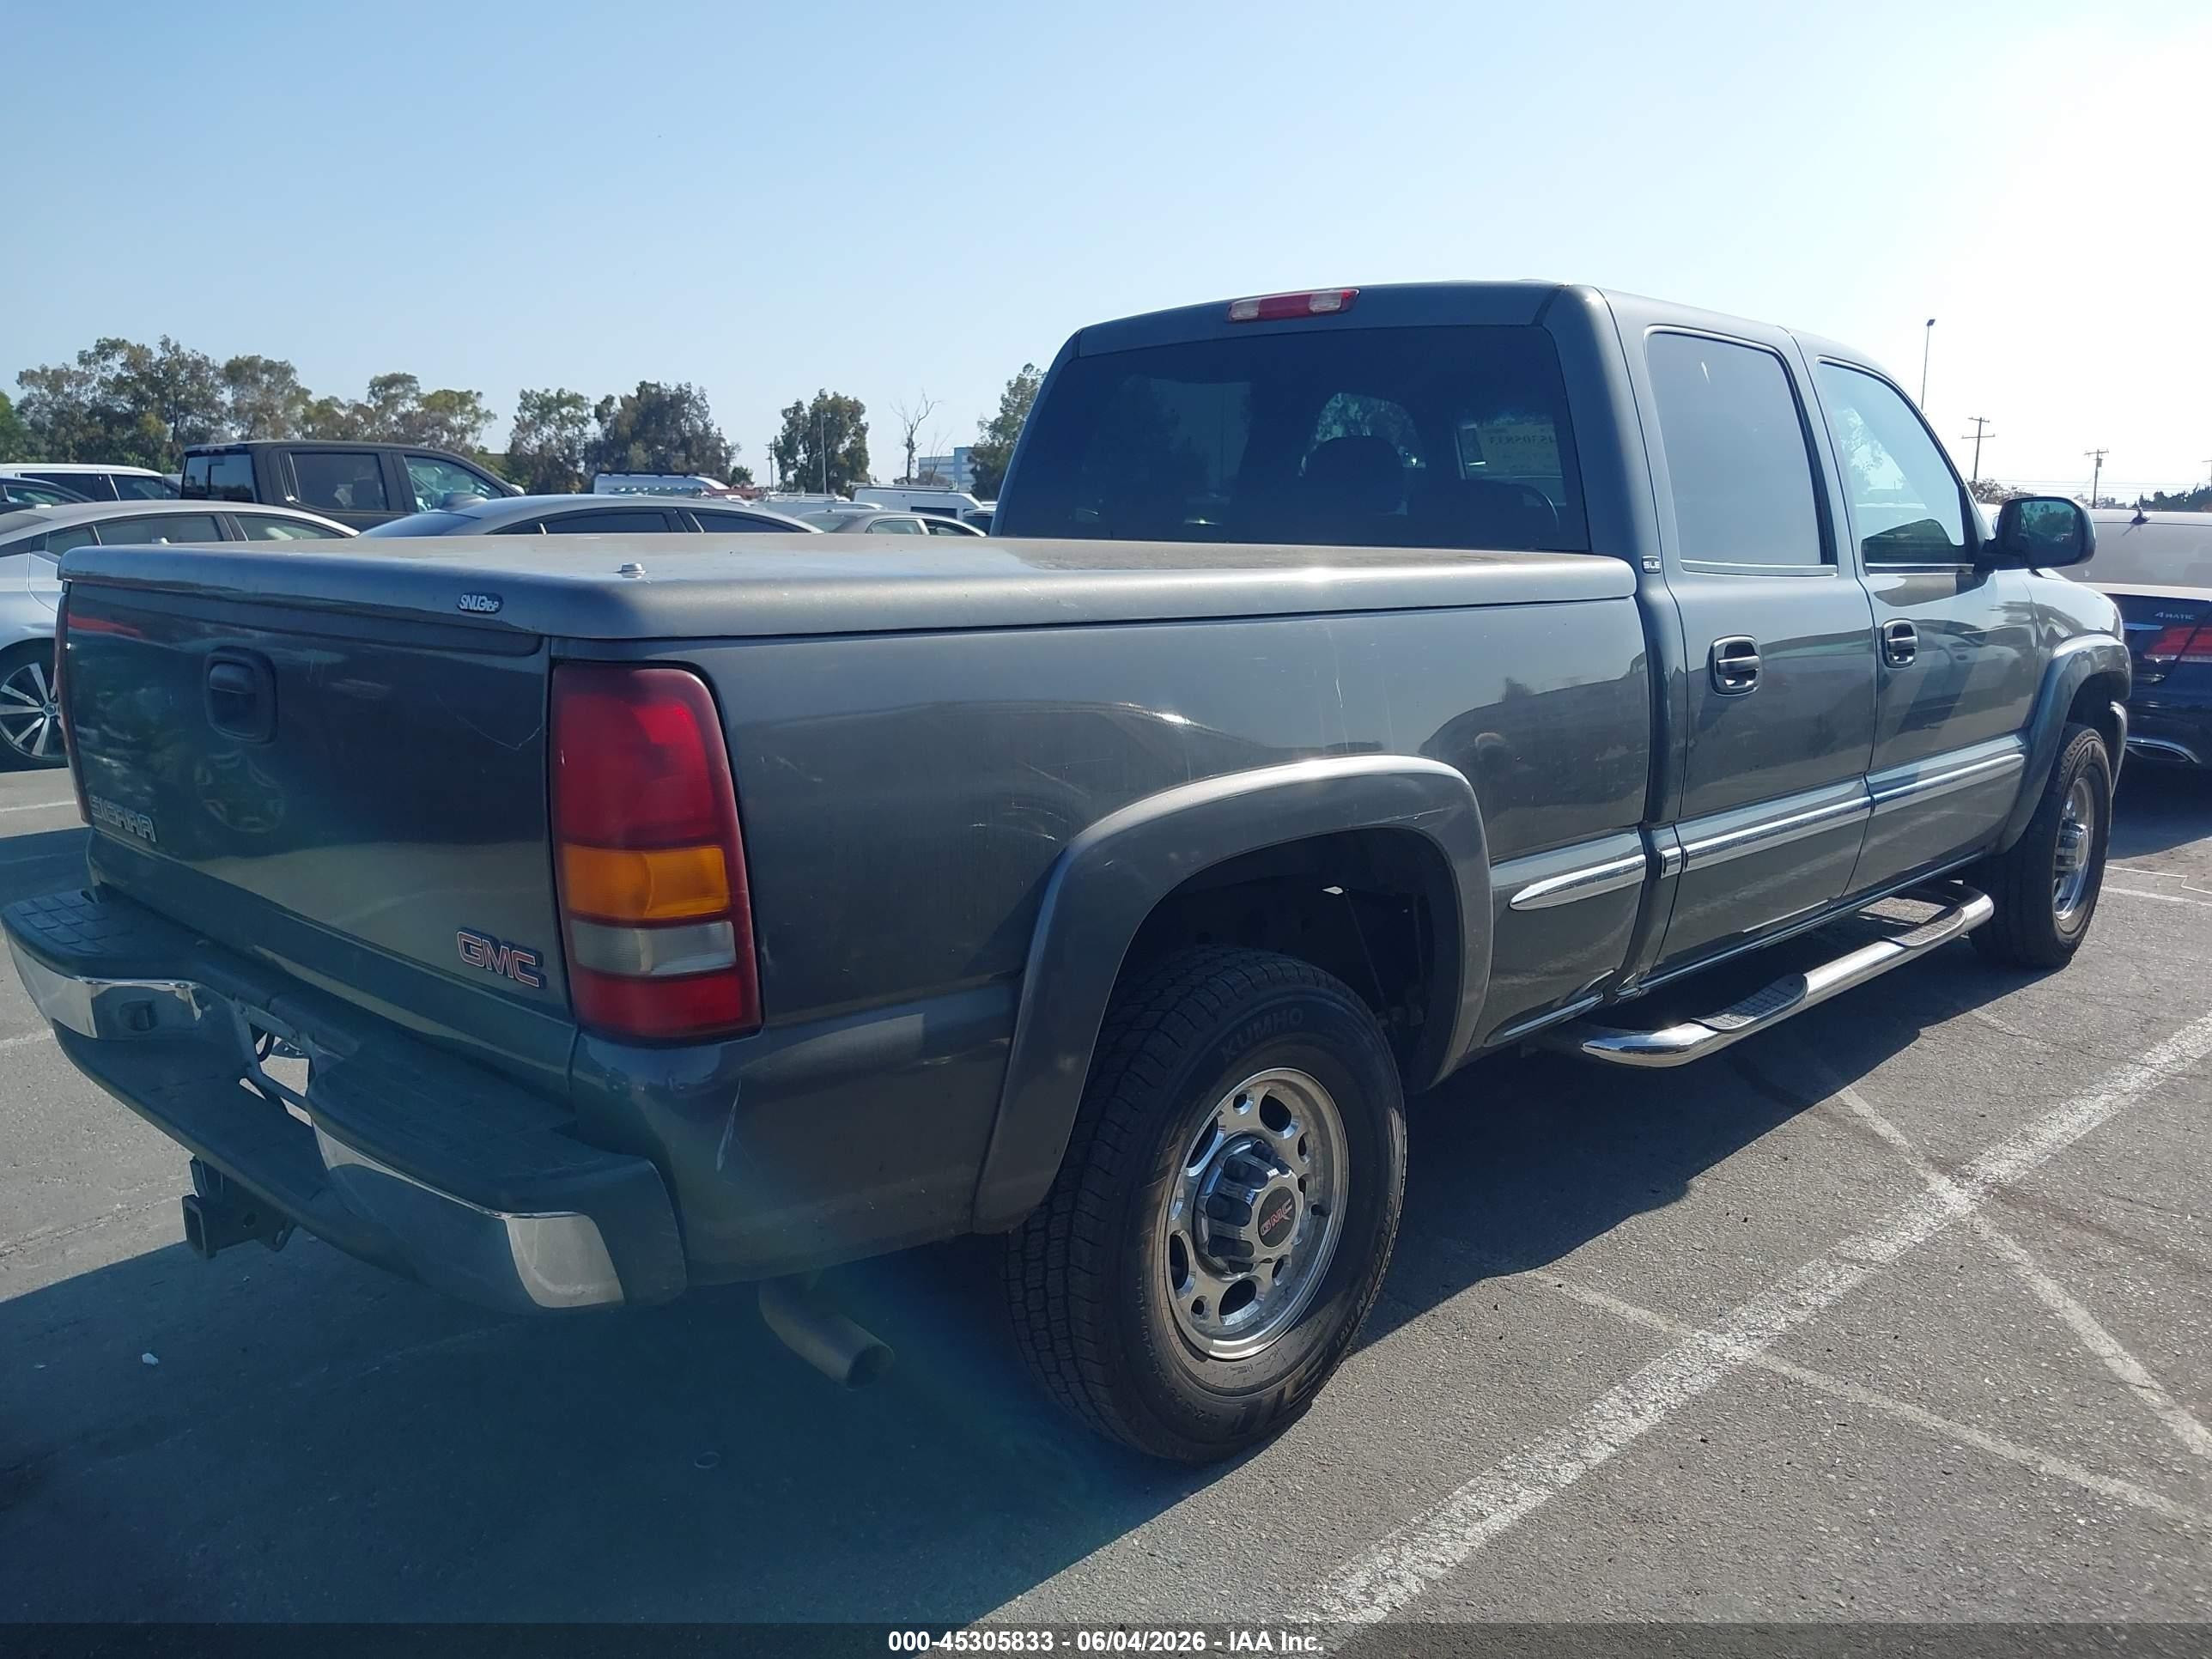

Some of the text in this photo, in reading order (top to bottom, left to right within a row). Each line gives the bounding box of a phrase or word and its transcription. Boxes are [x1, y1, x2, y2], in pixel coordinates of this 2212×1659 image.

[1643, 561, 1661, 569] SLE
[89, 794, 156, 842] SIERRA
[457, 931, 540, 988] GMC
[1220, 1007, 1304, 1065] KUMHO
[1260, 1198, 1293, 1237] GMC
